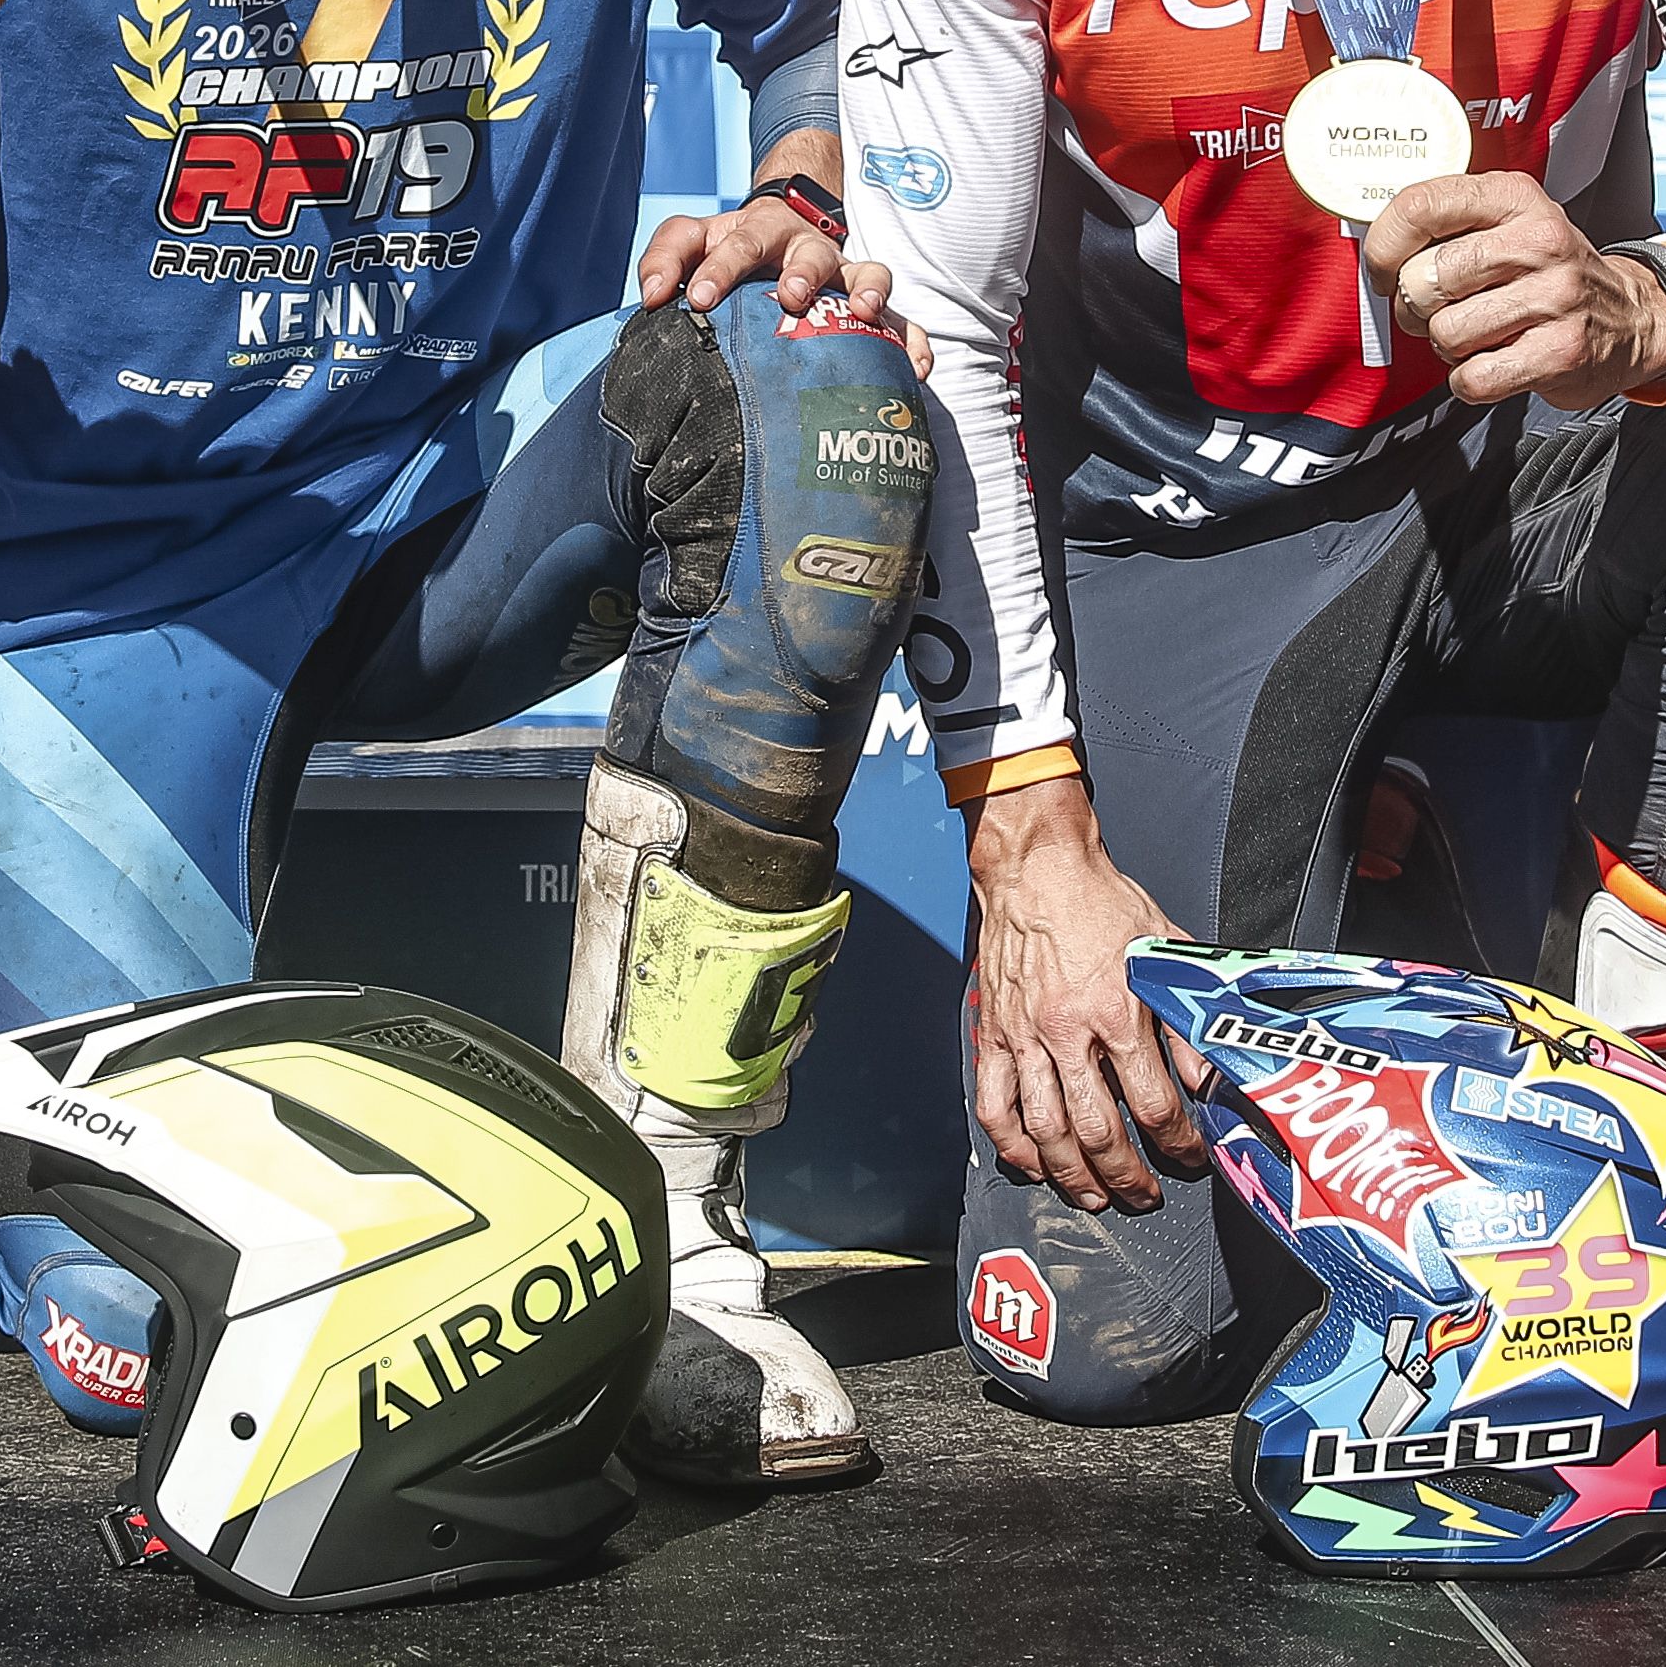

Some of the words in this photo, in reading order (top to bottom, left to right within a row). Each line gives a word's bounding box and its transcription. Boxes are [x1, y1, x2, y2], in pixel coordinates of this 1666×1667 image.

[191, 21, 297, 62] 2026
[178, 47, 495, 108] CHAMPION
[1189, 126, 1285, 160] TRIALG
[1327, 126, 1428, 142] WORLD
[1328, 142, 1427, 160] CHAMPION
[1361, 187, 1396, 201] 2026
[149, 242, 319, 284] ARNAU
[238, 281, 416, 347] KENNY
[250, 345, 315, 367] MOTOREX
[116, 368, 213, 399] GALFER
[816, 429, 933, 474] MOTORE
[815, 464, 847, 483] Oil
[851, 466, 872, 484] of
[1205, 1014, 1389, 1074] hebo
[26, 1093, 138, 1148] AIROH
[1507, 1088, 1622, 1149] SPEA
[1452, 1214, 1548, 1241] BOU
[1494, 1235, 1650, 1318] 39
[359, 1216, 643, 1434] AIROH
[1500, 1311, 1634, 1342] WORLD
[974, 1330, 1042, 1373] Montesa
[1499, 1336, 1634, 1364] CHAMPION
[72, 1371, 125, 1406] SUPER
[1303, 1416, 1603, 1484] hebo
